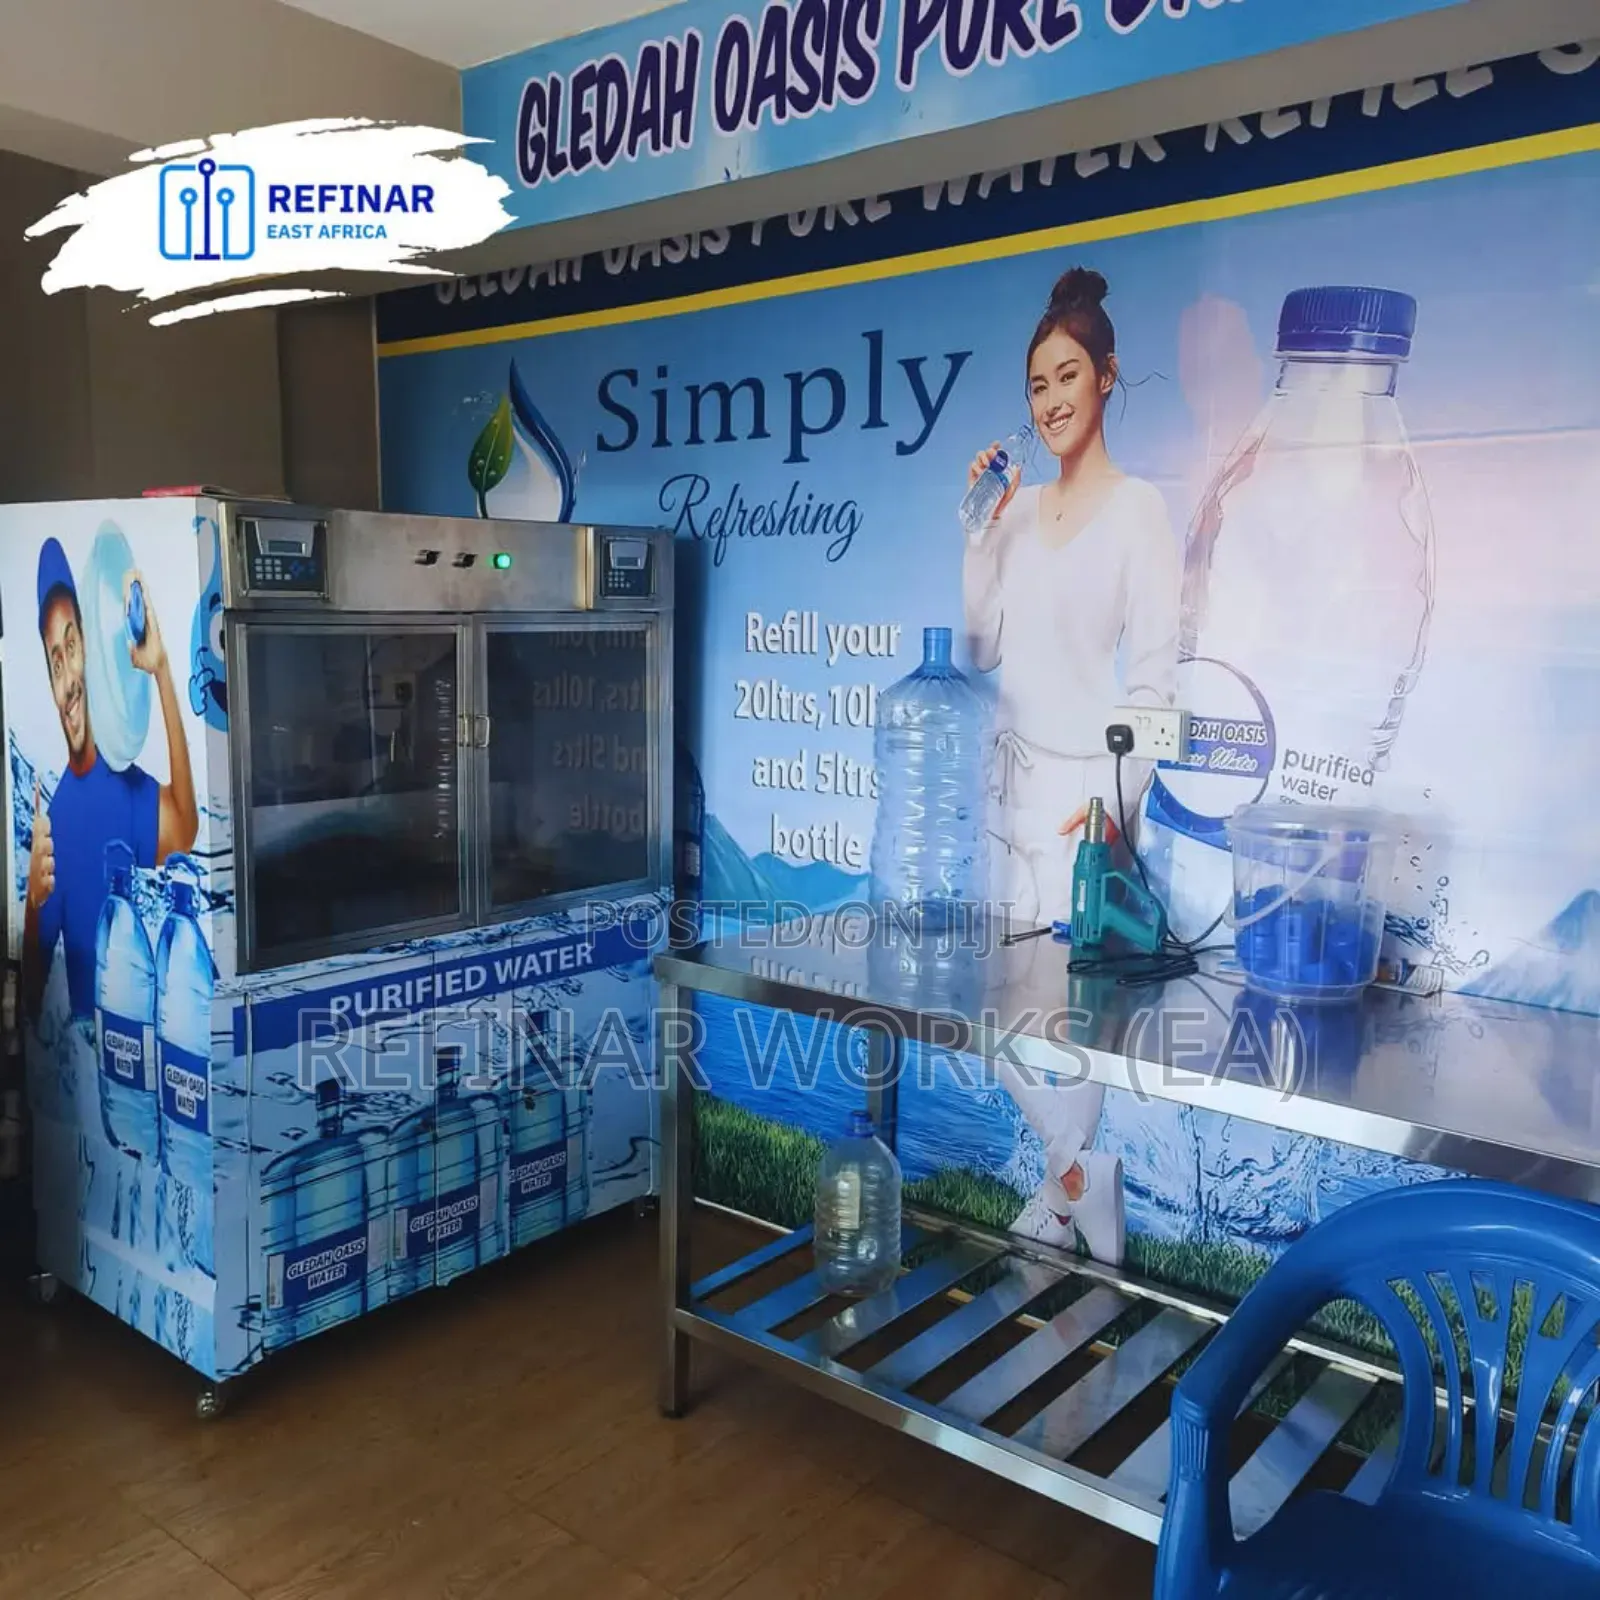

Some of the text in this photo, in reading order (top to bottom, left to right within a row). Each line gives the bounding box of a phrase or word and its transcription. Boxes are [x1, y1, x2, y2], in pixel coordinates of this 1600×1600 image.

[517, 30, 701, 187] GLEDAH
[713, 0, 884, 133] OASIS
[596, 329, 973, 464] Simply
[658, 473, 864, 568] Refreshing
[745, 610, 902, 667] Refill your
[734, 678, 881, 731] 20ltrs, 10l
[1189, 720, 1267, 745] DAH OASIS
[752, 748, 880, 800] and 5ltrs
[1208, 746, 1259, 773] Water
[1283, 748, 1375, 787] purified
[1282, 773, 1339, 802] water
[771, 812, 863, 869] bottle
[329, 942, 593, 1024] PURIFIED WATER
[410, 1195, 479, 1233] GLEDAH OASIS
[286, 1237, 367, 1280] GLEDAH OASIS
[308, 1262, 348, 1290] WATER
